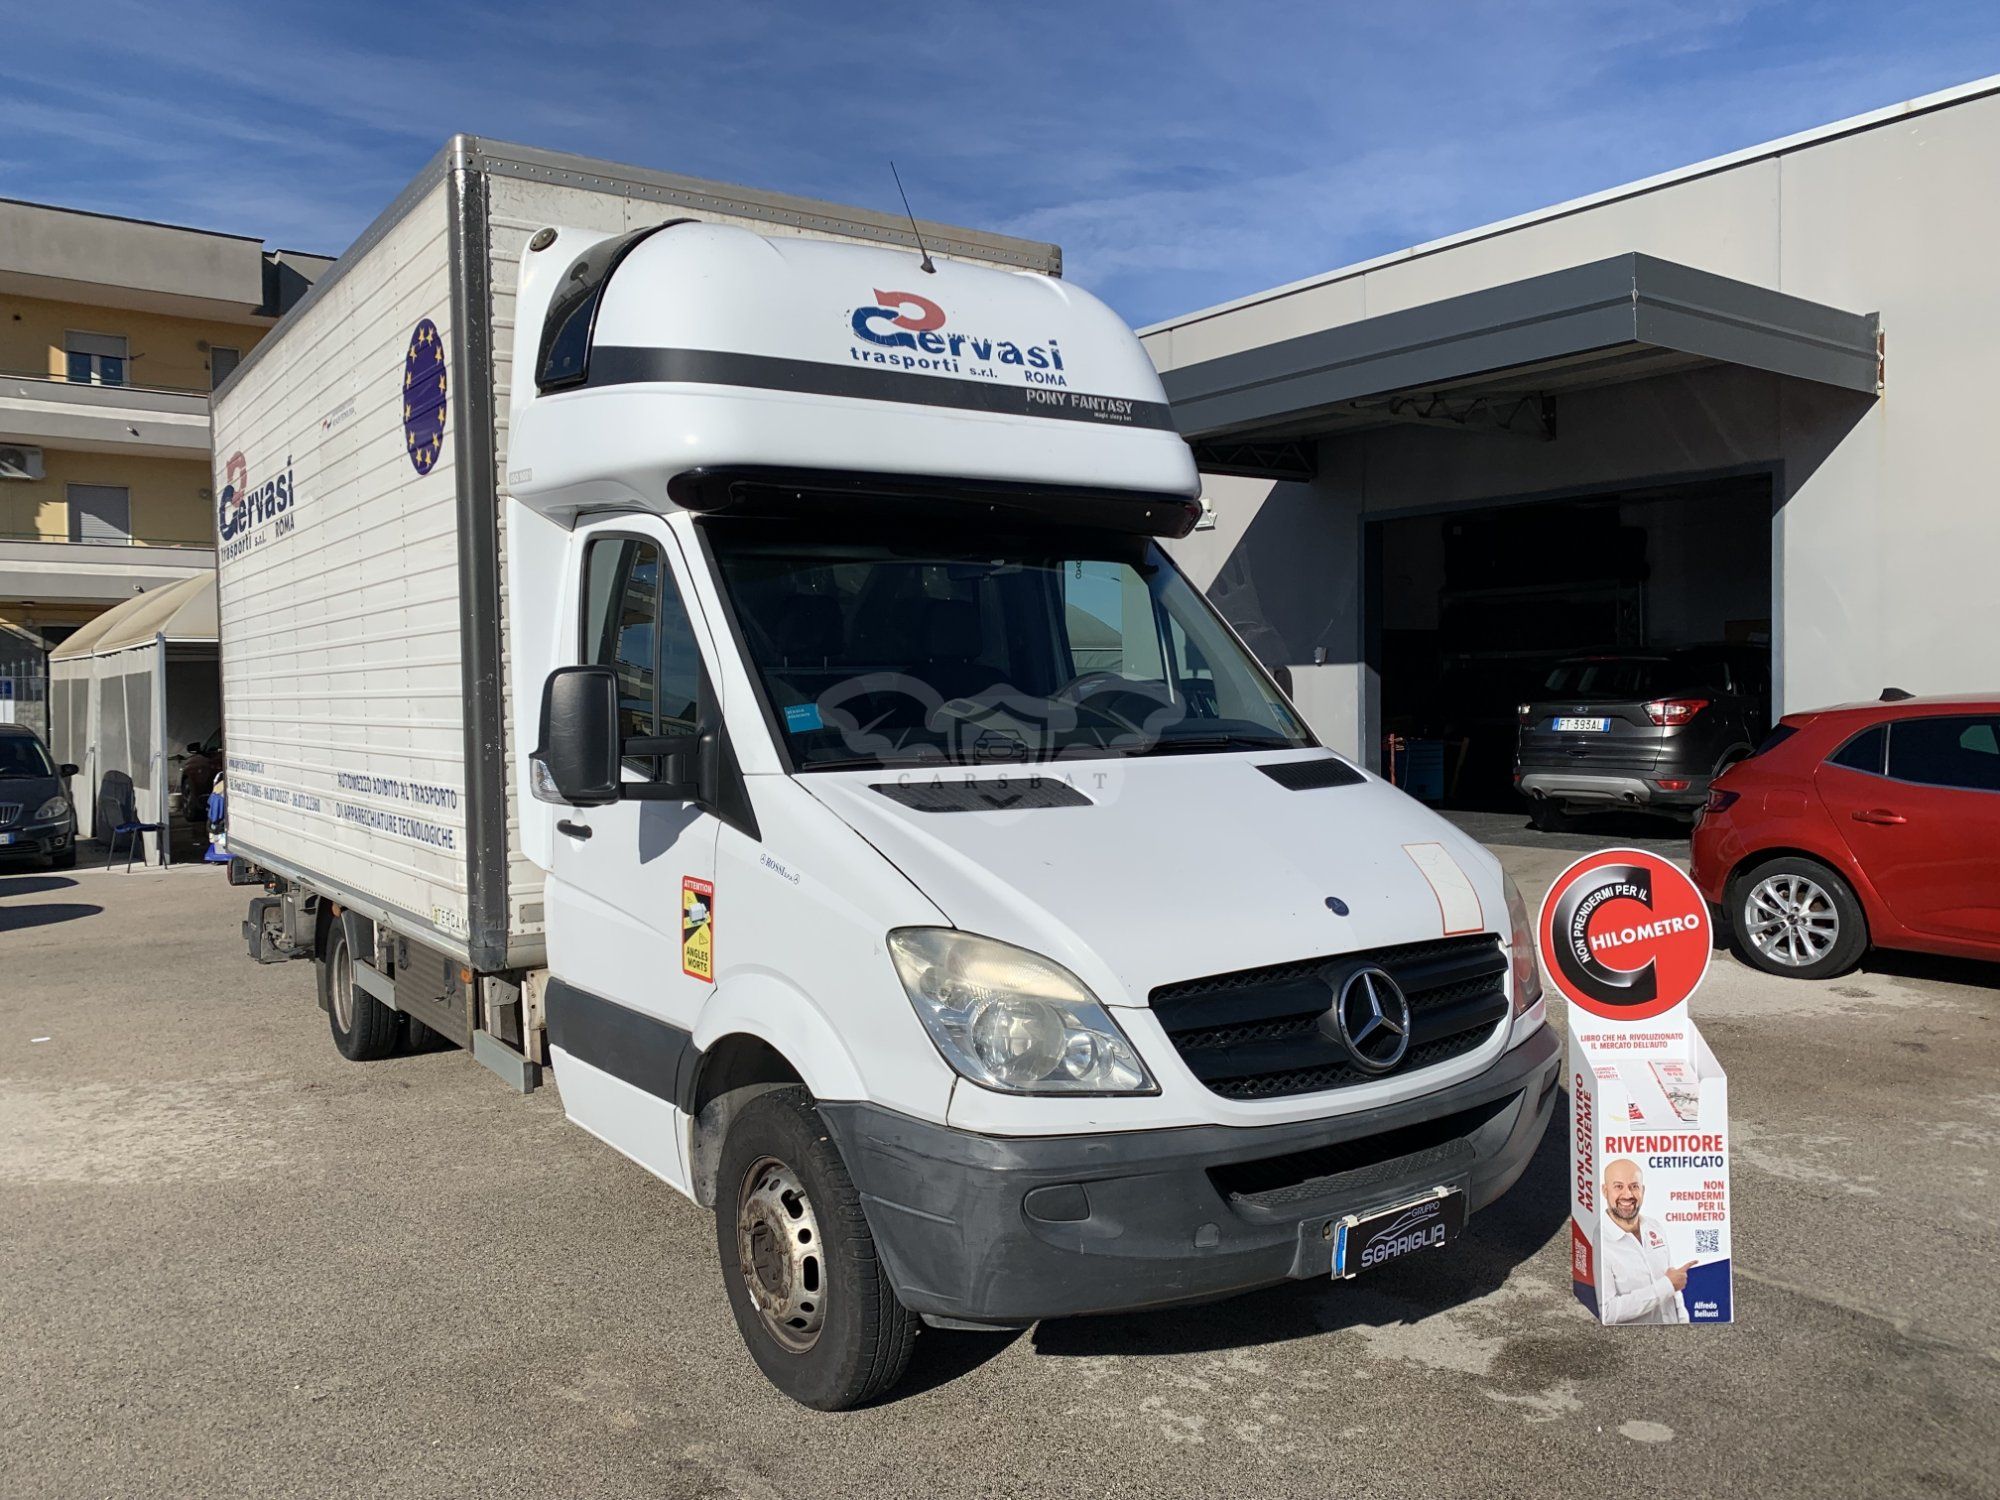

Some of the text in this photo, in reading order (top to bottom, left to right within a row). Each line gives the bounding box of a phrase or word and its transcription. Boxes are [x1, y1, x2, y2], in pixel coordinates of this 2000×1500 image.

[852, 289, 1065, 371] Gervasi
[850, 347, 998, 378] trasporti s.r.l.
[1024, 370, 1067, 387] ROMA
[1026, 389, 1133, 414] PONY FANTASY
[219, 452, 294, 541] Gervasi
[220, 531, 252, 562] trasporti
[275, 513, 295, 538] ROMA
[337, 772, 457, 810] AUTOMEZZO ADIBITO AL TRASPORTO
[344, 805, 397, 833] APPARECCHIATURE
[765, 857, 785, 876] ROSSI
[684, 880, 713, 894] ATTENTION
[1573, 885, 1648, 964] NON PRENDERMI PER IL
[686, 946, 708, 962] ANGLES
[687, 959, 708, 973] MORTS
[1581, 1034, 1600, 1042] LIBRO
[1629, 1033, 1684, 1041] RIVOLUZIONATO
[1591, 1042, 1597, 1050] IL
[1633, 1041, 1668, 1049] DELL'AUTO
[1576, 1073, 1585, 1206] NON CONTRO
[1605, 1135, 1724, 1153] RIVENDITORE
[1584, 1090, 1594, 1213] MA INSIEME
[1648, 1156, 1724, 1169] CERTIFICATO
[1703, 1181, 1724, 1190] NON
[1670, 1191, 1725, 1201] PRENDERMI
[1411, 1201, 1440, 1217] GRUPPO
[1697, 1202, 1725, 1211] PER IL
[1665, 1212, 1725, 1222] CHILOMETRO
[1361, 1223, 1446, 1268] SGARIGLIA
[1694, 1302, 1718, 1310] Alfredo
[1694, 1310, 1719, 1318] Bellucci
